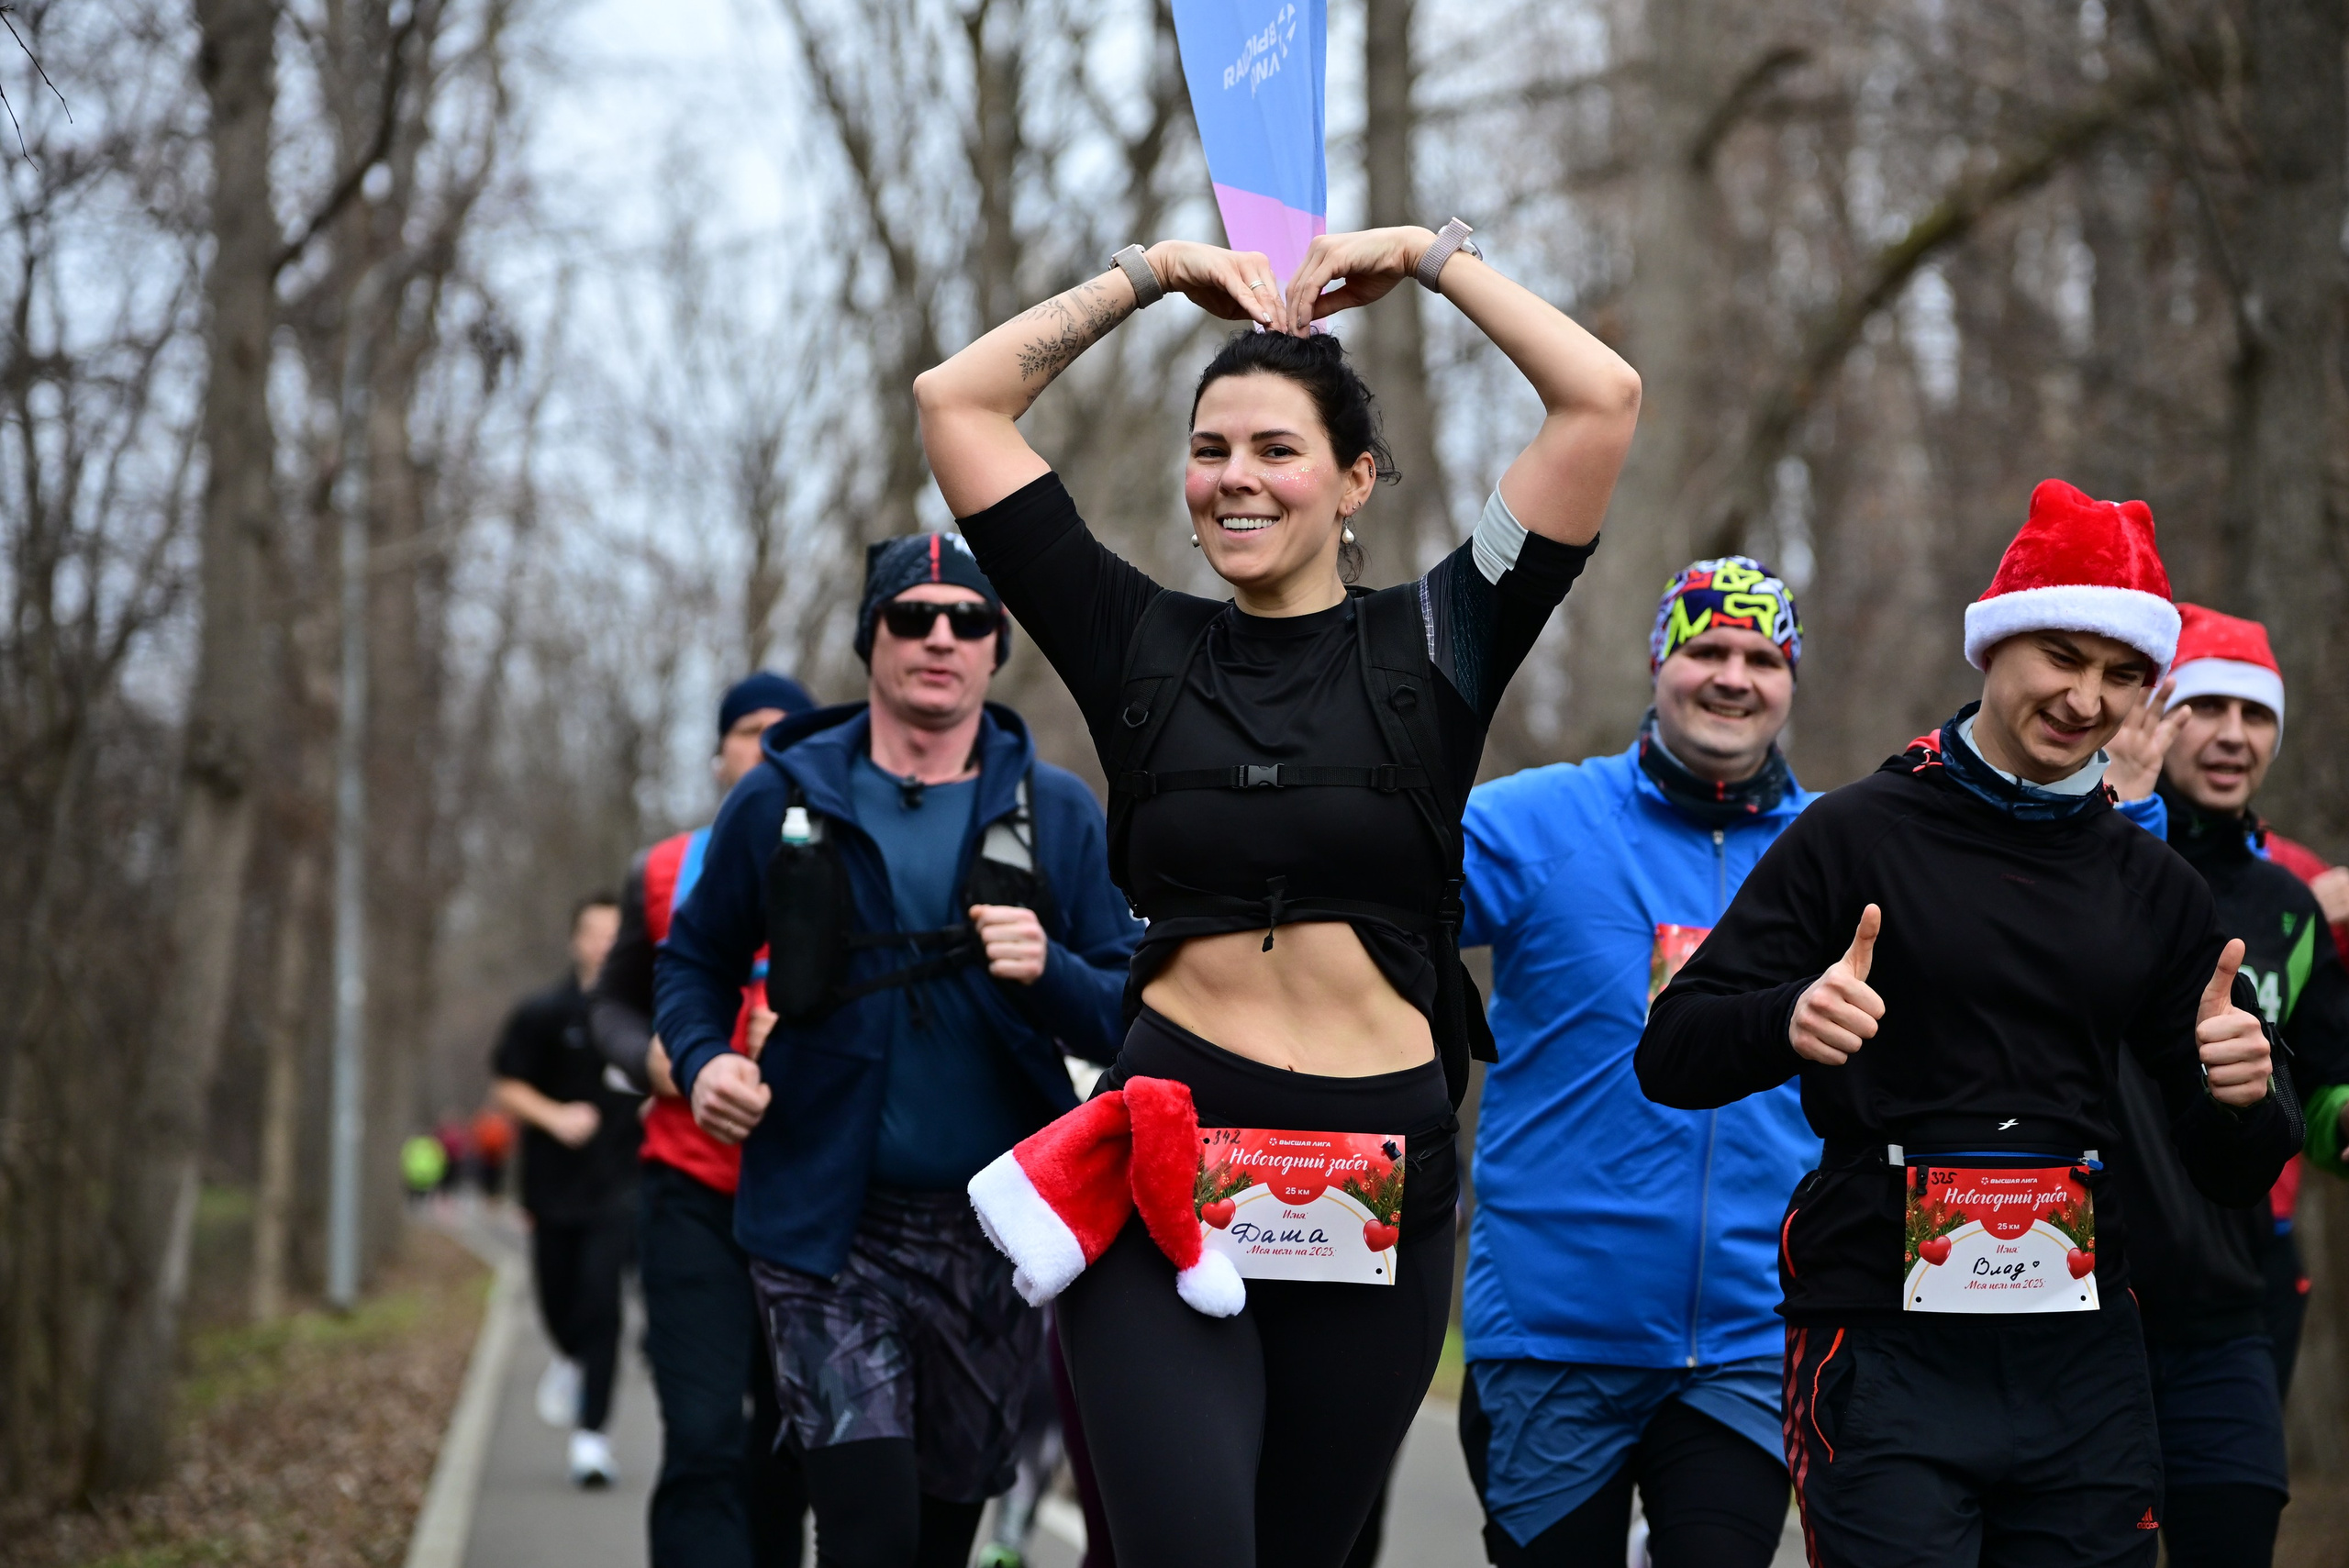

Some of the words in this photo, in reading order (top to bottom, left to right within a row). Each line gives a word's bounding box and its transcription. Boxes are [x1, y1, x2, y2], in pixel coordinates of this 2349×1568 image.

[1212, 1129, 1241, 1145] 342
[1230, 1147, 1325, 1175] Новогодний
[1325, 1153, 1368, 1177] забег
[1931, 1172, 1958, 1184] 325
[1943, 1187, 2032, 1212] Новогодний
[2032, 1185, 2067, 1211] забег
[1282, 1209, 1308, 1219] Имя:
[1230, 1223, 1330, 1243] Даша
[1246, 1245, 1270, 1254] Моя
[1272, 1247, 1293, 1256] цель
[1308, 1247, 1337, 1257] 2025:
[1973, 1257, 2026, 1282] Влад
[1965, 1280, 1987, 1289] Моя
[2022, 1278, 2047, 1289] 2025:
